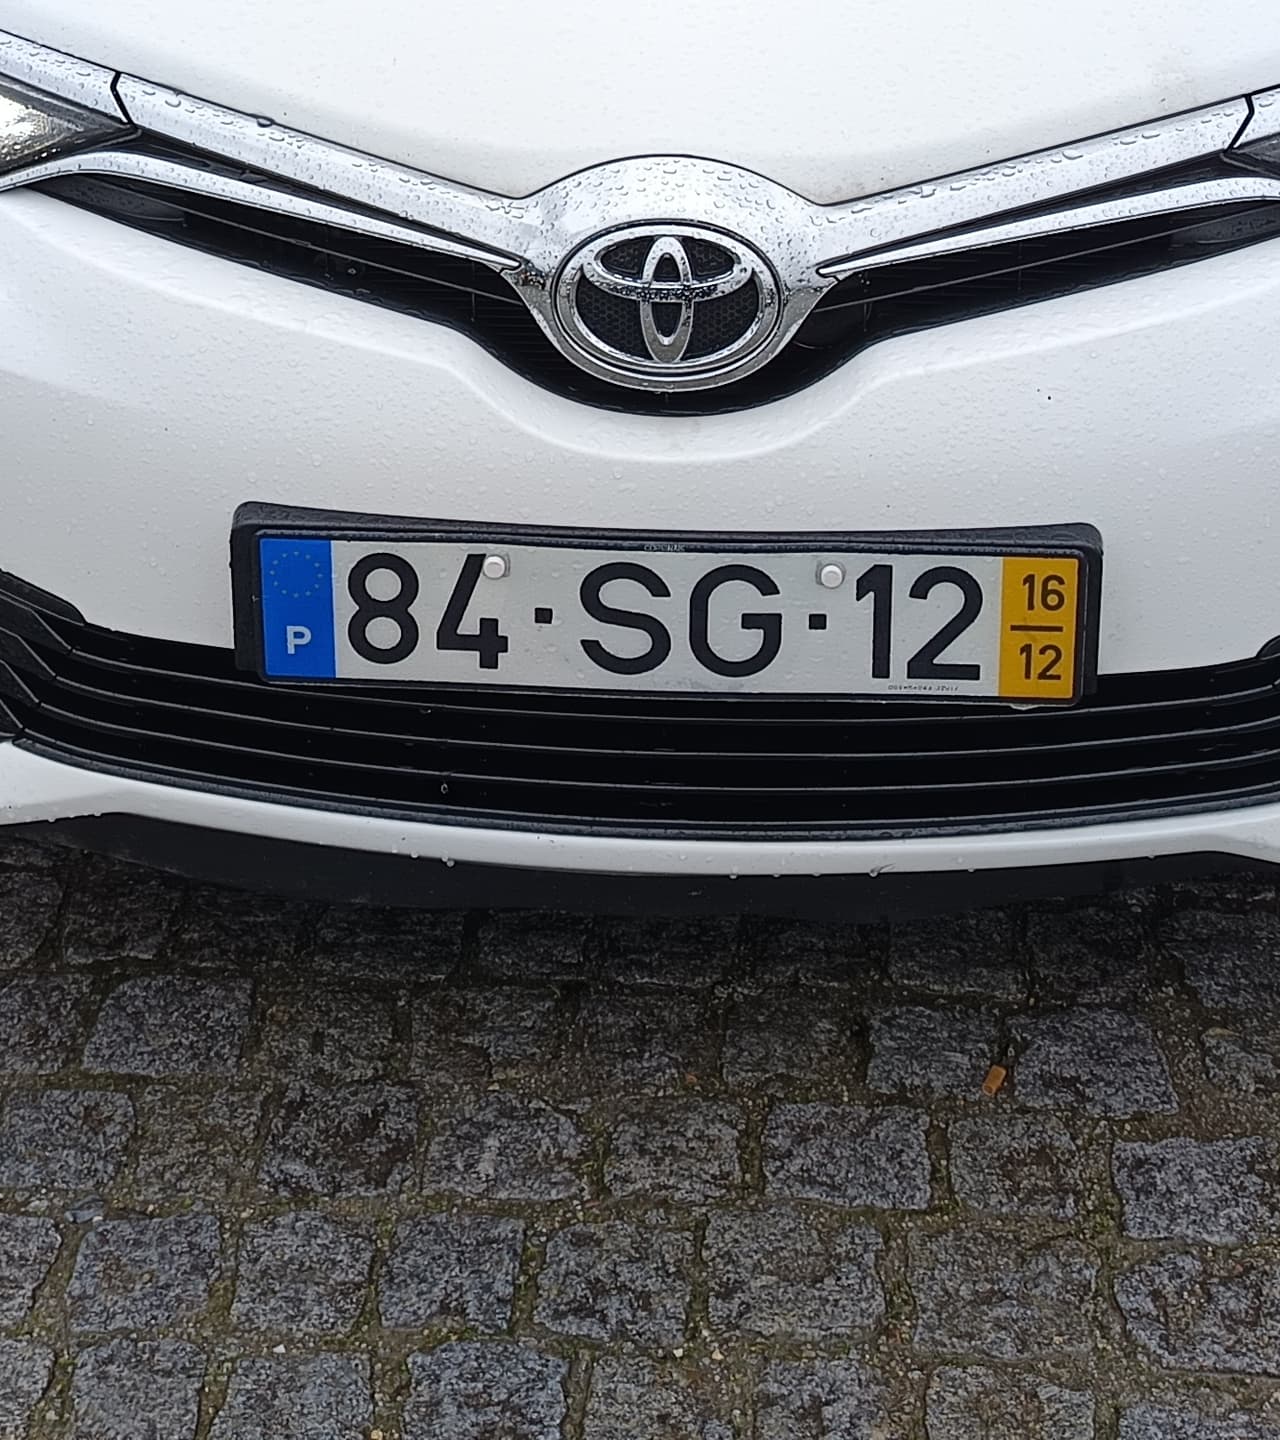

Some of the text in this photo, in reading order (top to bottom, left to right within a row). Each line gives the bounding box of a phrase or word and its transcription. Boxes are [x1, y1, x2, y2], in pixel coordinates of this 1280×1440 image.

[1022, 574, 1066, 611] 16
[285, 625, 312, 655] P
[1019, 643, 1063, 680] 12
